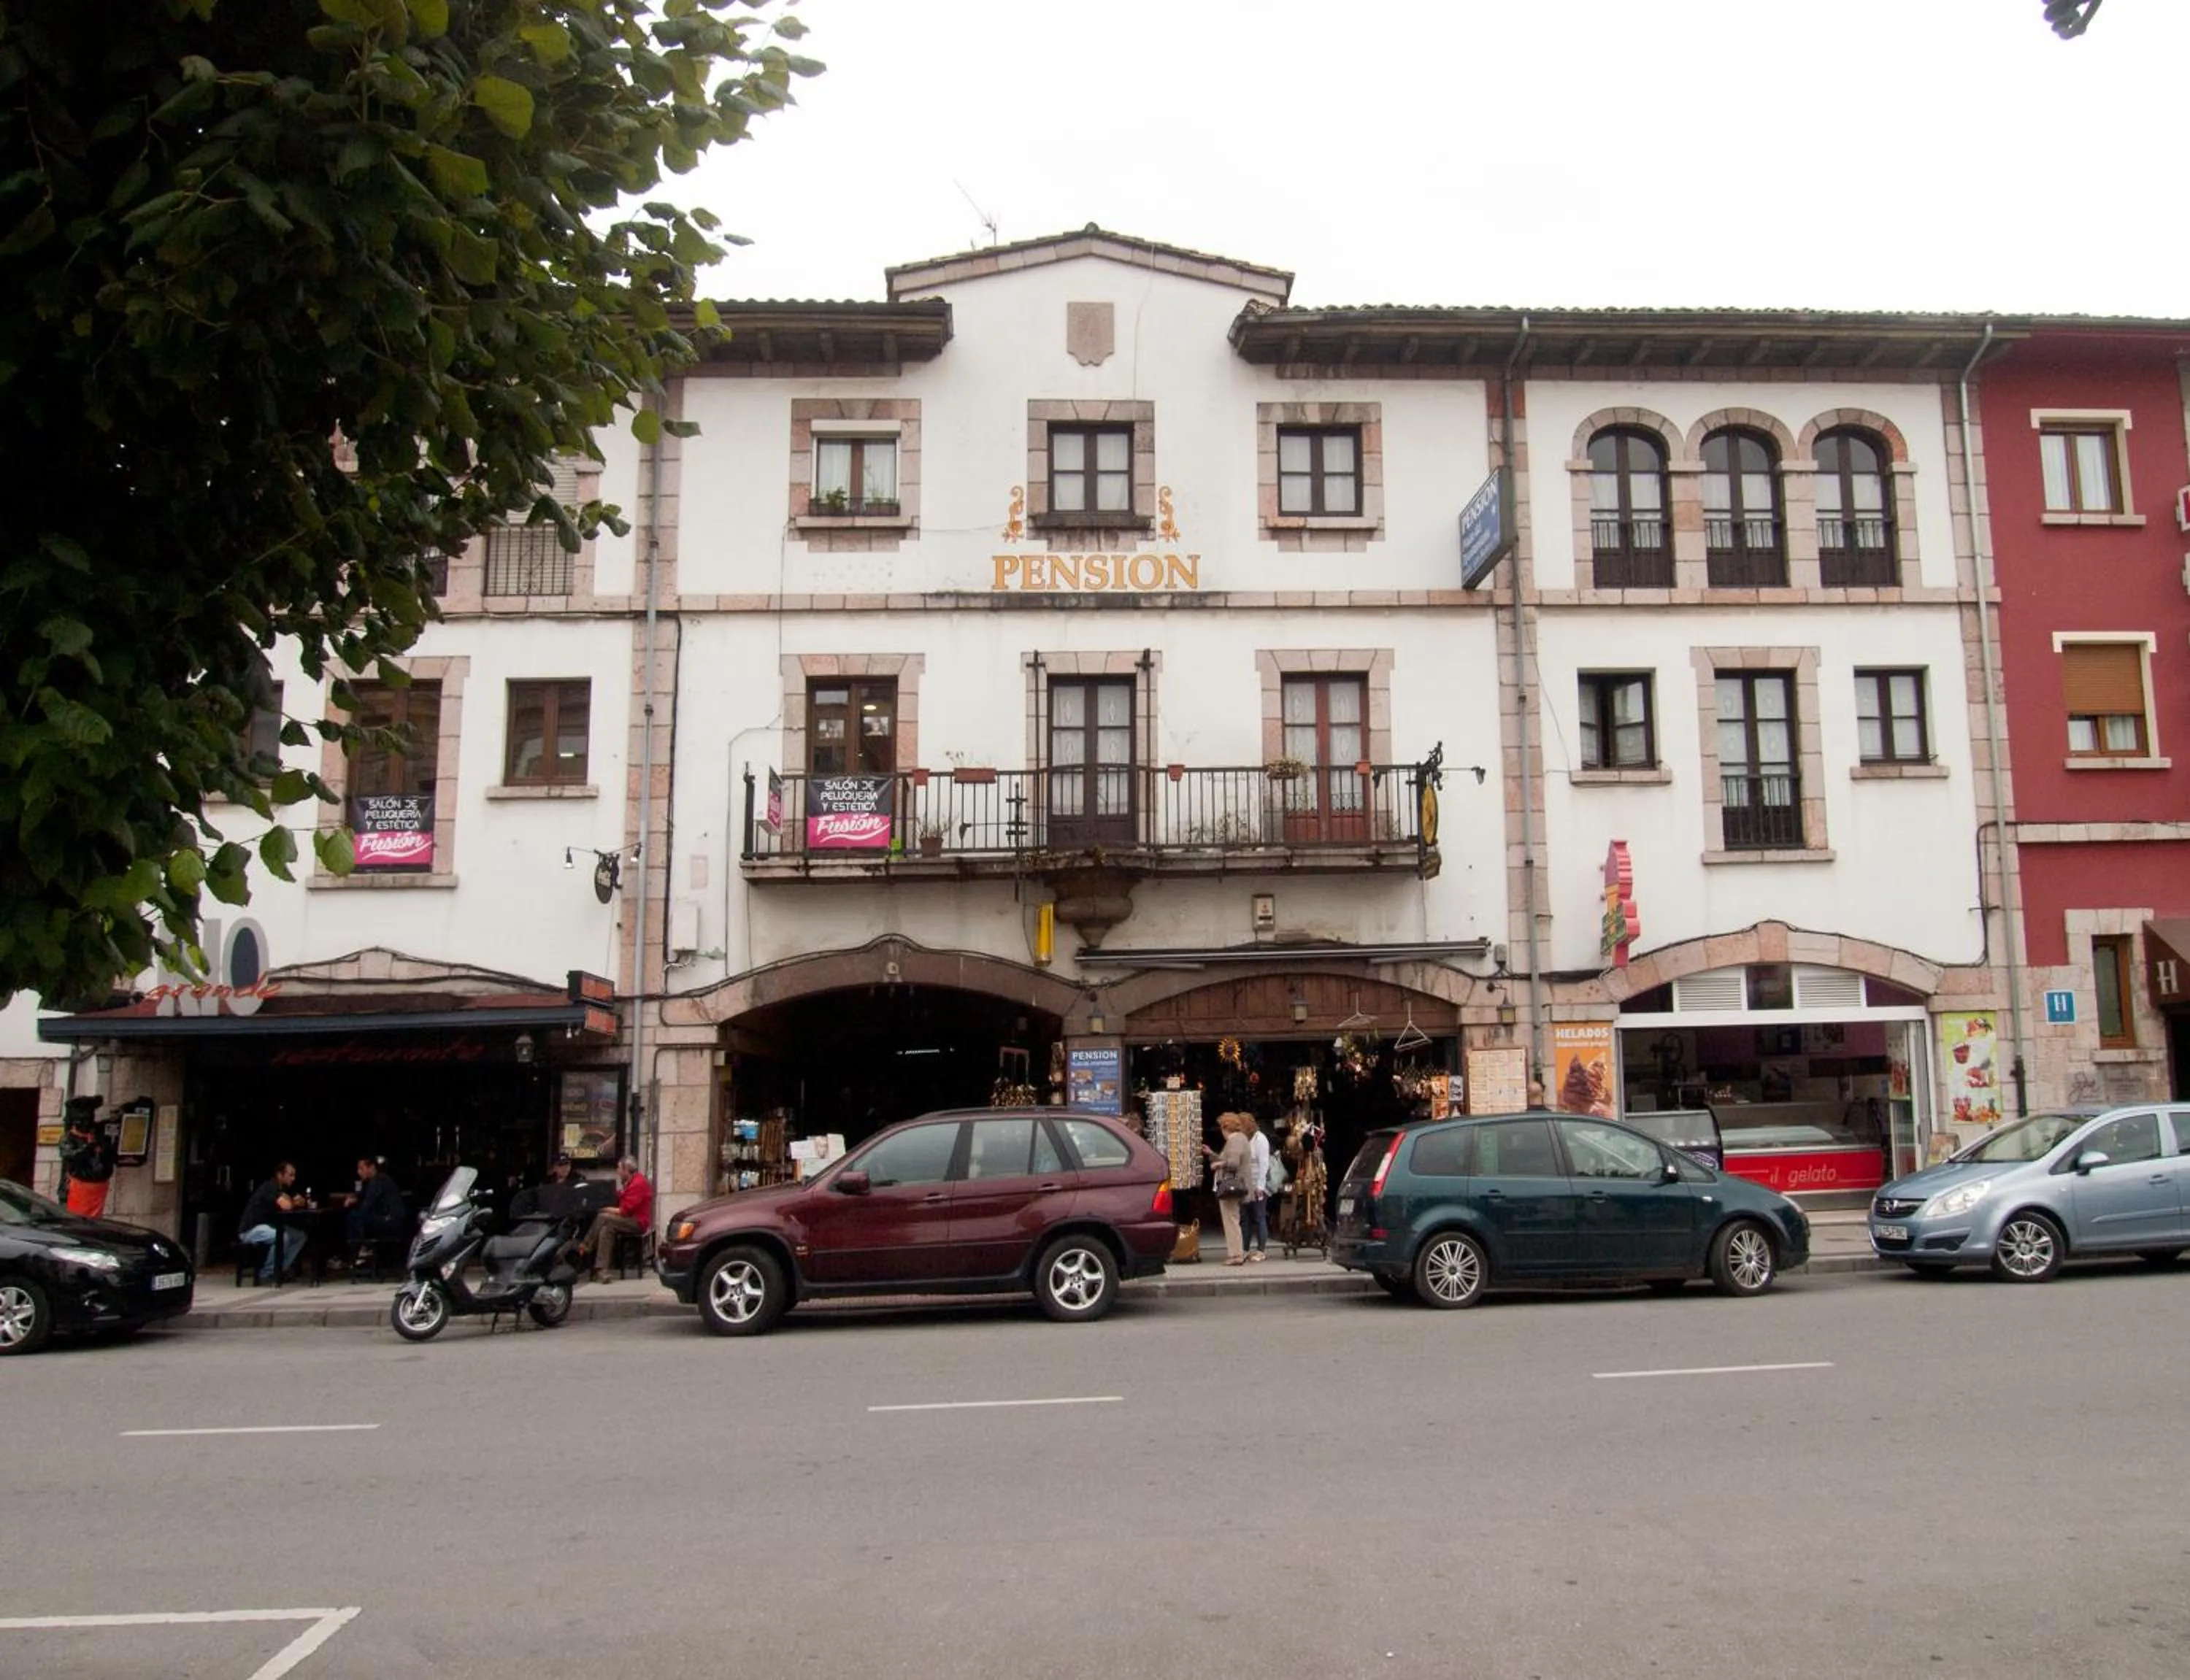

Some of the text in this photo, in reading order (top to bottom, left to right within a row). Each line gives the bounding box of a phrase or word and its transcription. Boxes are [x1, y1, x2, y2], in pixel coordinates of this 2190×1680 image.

[991, 554, 1202, 590] PENSION
[824, 777, 875, 790] SALÓN DE
[368, 795, 419, 809] SALÓN DE
[820, 790, 879, 801] PELUQUERÍA
[821, 801, 877, 812] Y ESTÉTICA
[366, 818, 420, 830] Y ESTÉTICA
[817, 813, 883, 836] Fusión
[358, 831, 426, 853] Fusión
[2156, 959, 2180, 995] H
[2053, 994, 2067, 1012] H
[1554, 1027, 1610, 1039] HELADOS
[1072, 1051, 1118, 1060] PENSION
[1787, 1163, 1837, 1187] gelato
